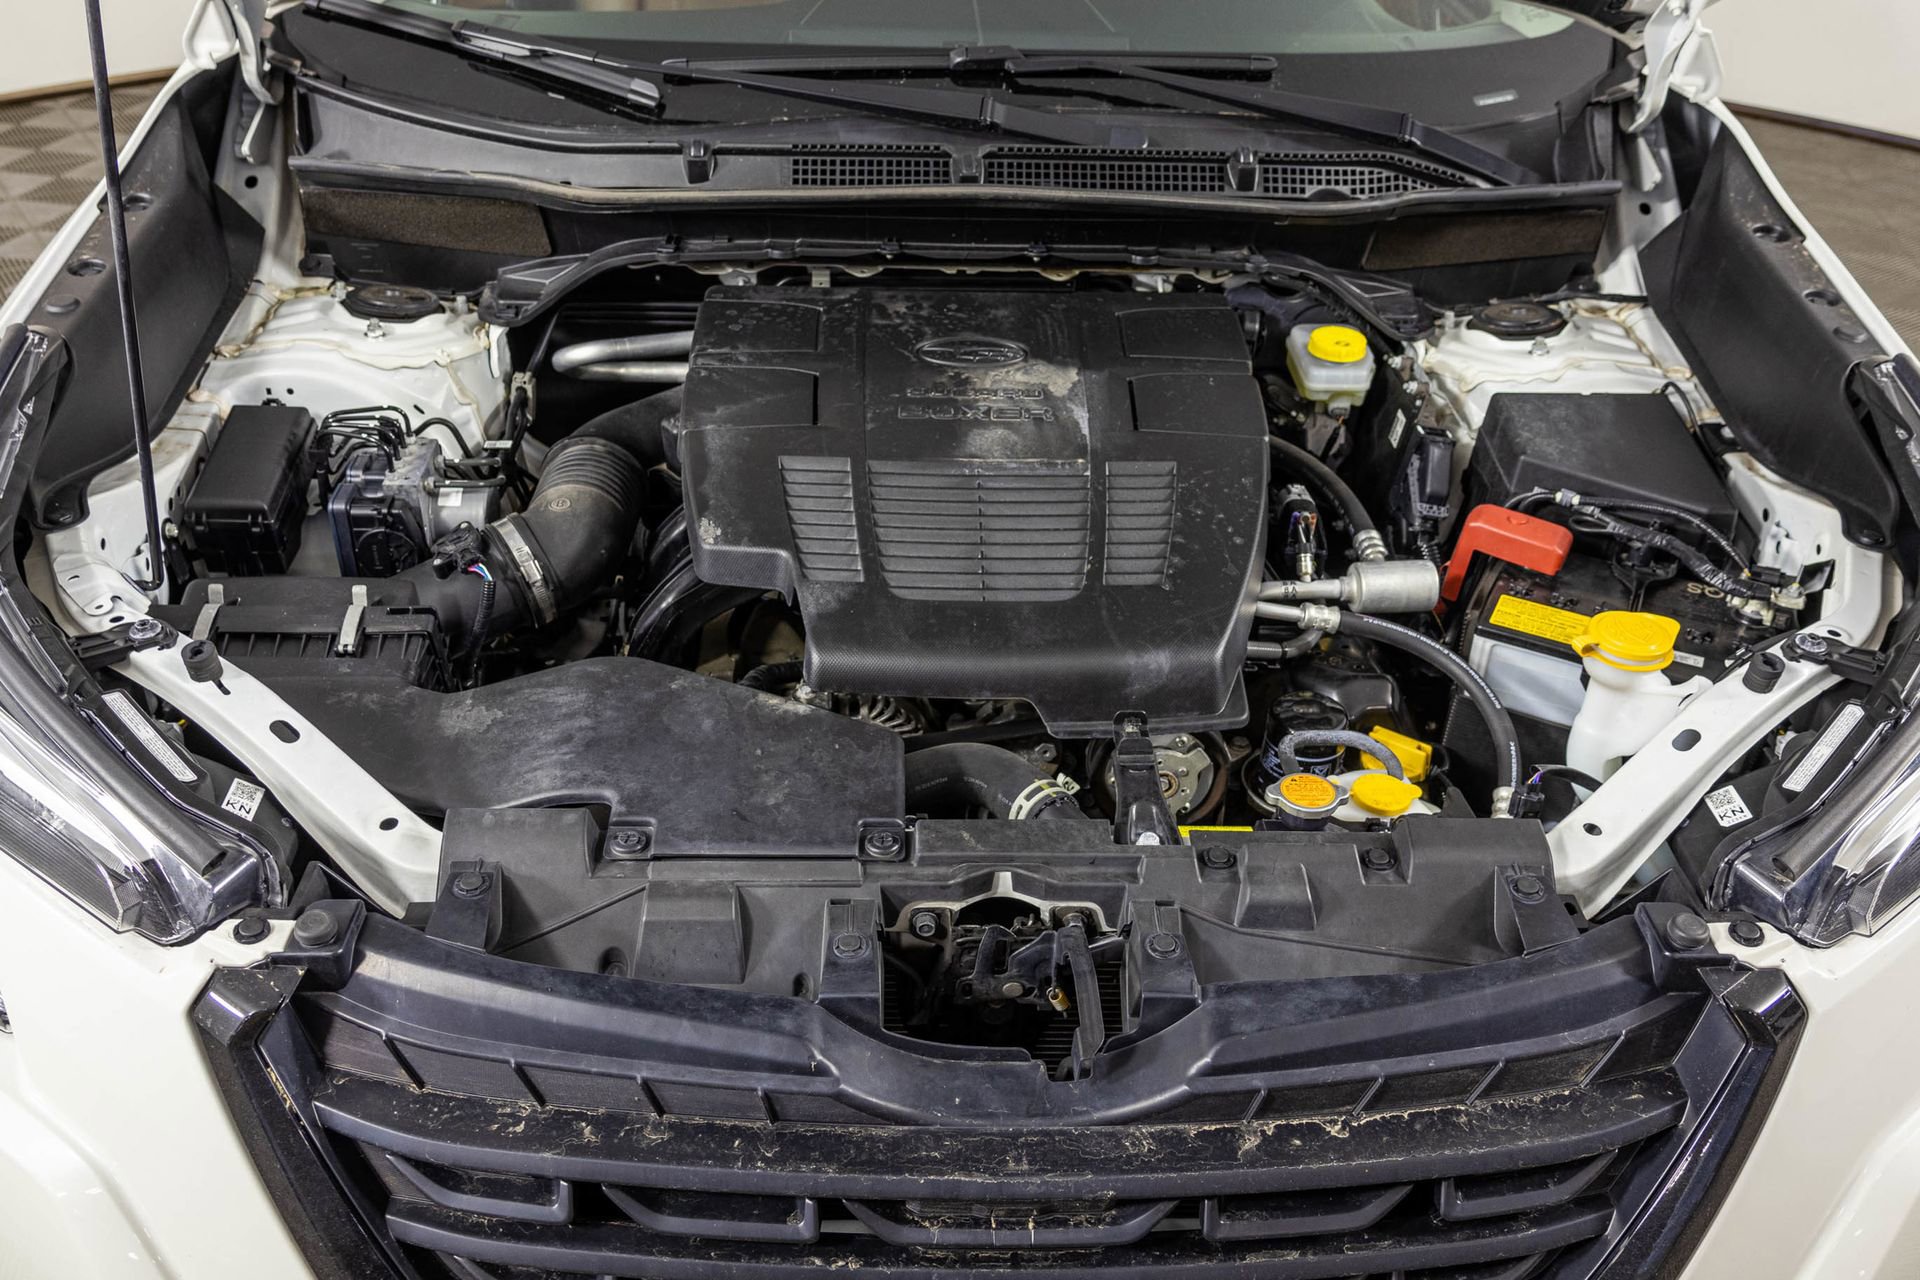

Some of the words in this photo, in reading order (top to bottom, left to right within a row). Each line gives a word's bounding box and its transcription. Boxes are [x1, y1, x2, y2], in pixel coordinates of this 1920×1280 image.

[906, 386, 1045, 400] SUBARU
[897, 404, 1055, 421] BOXER
[225, 799, 252, 815] KN
[1718, 806, 1745, 821] KN
